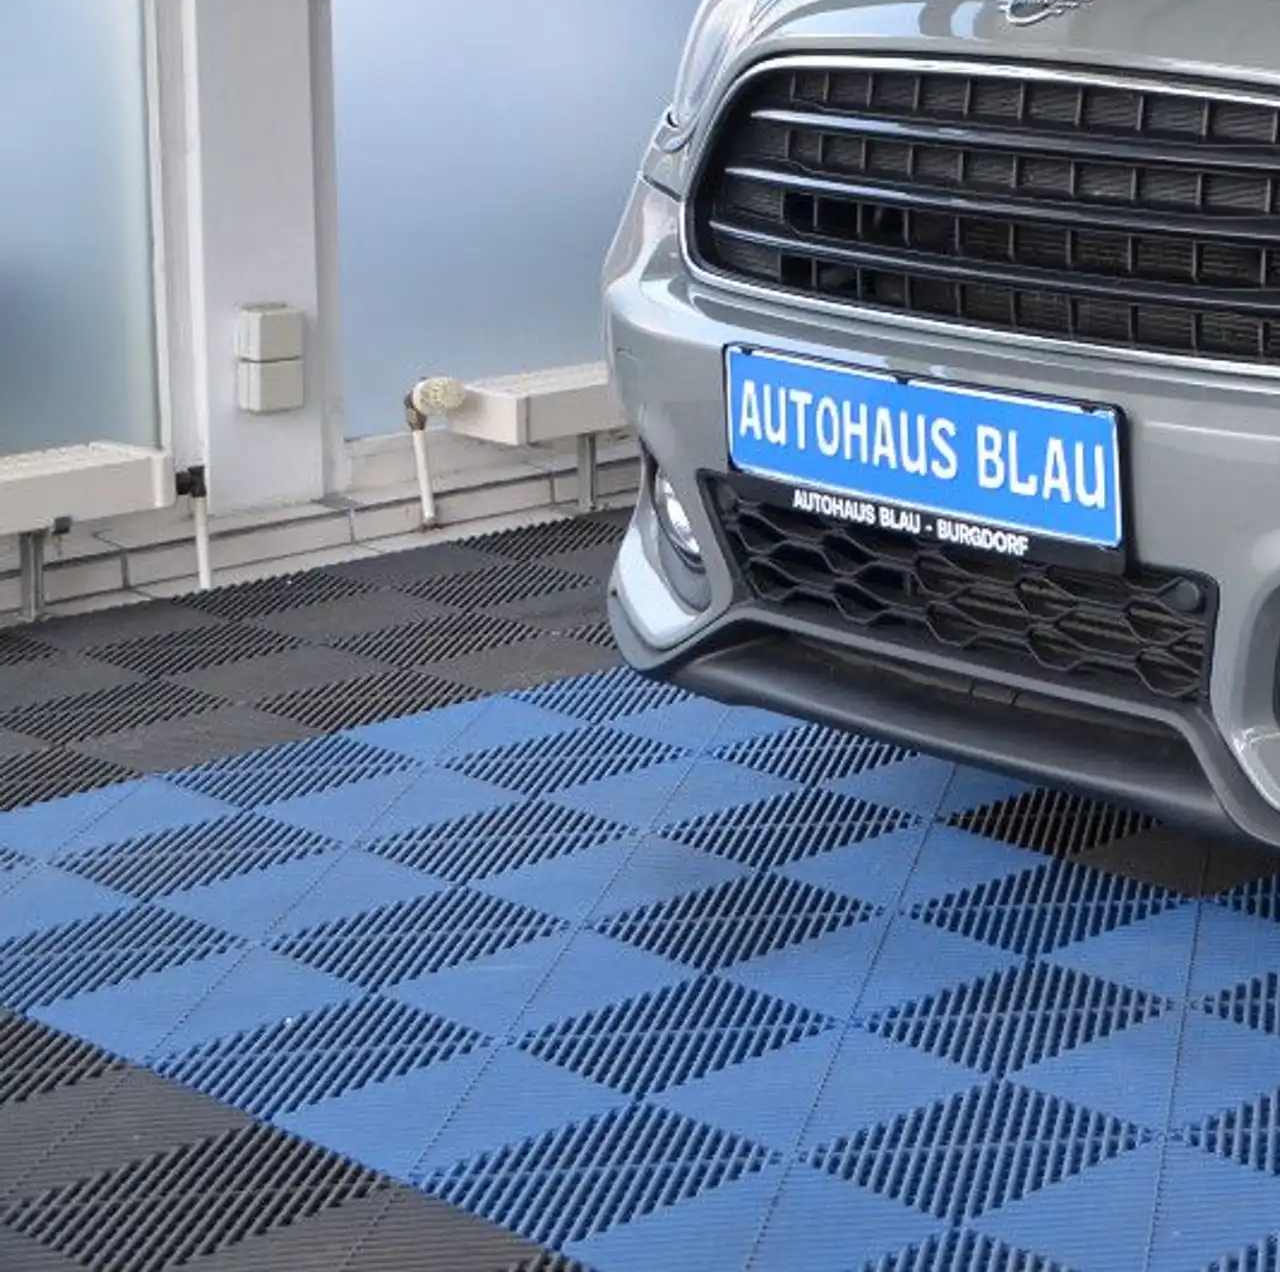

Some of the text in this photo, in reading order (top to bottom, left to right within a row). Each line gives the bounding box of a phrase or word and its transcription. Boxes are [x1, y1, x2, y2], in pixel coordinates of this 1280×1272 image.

[739, 379, 1105, 509] AUTOHAUS BLAU
[793, 489, 876, 525] AUTOHAUS
[878, 506, 921, 534] BLAU
[936, 517, 1029, 557] BURGDORF
